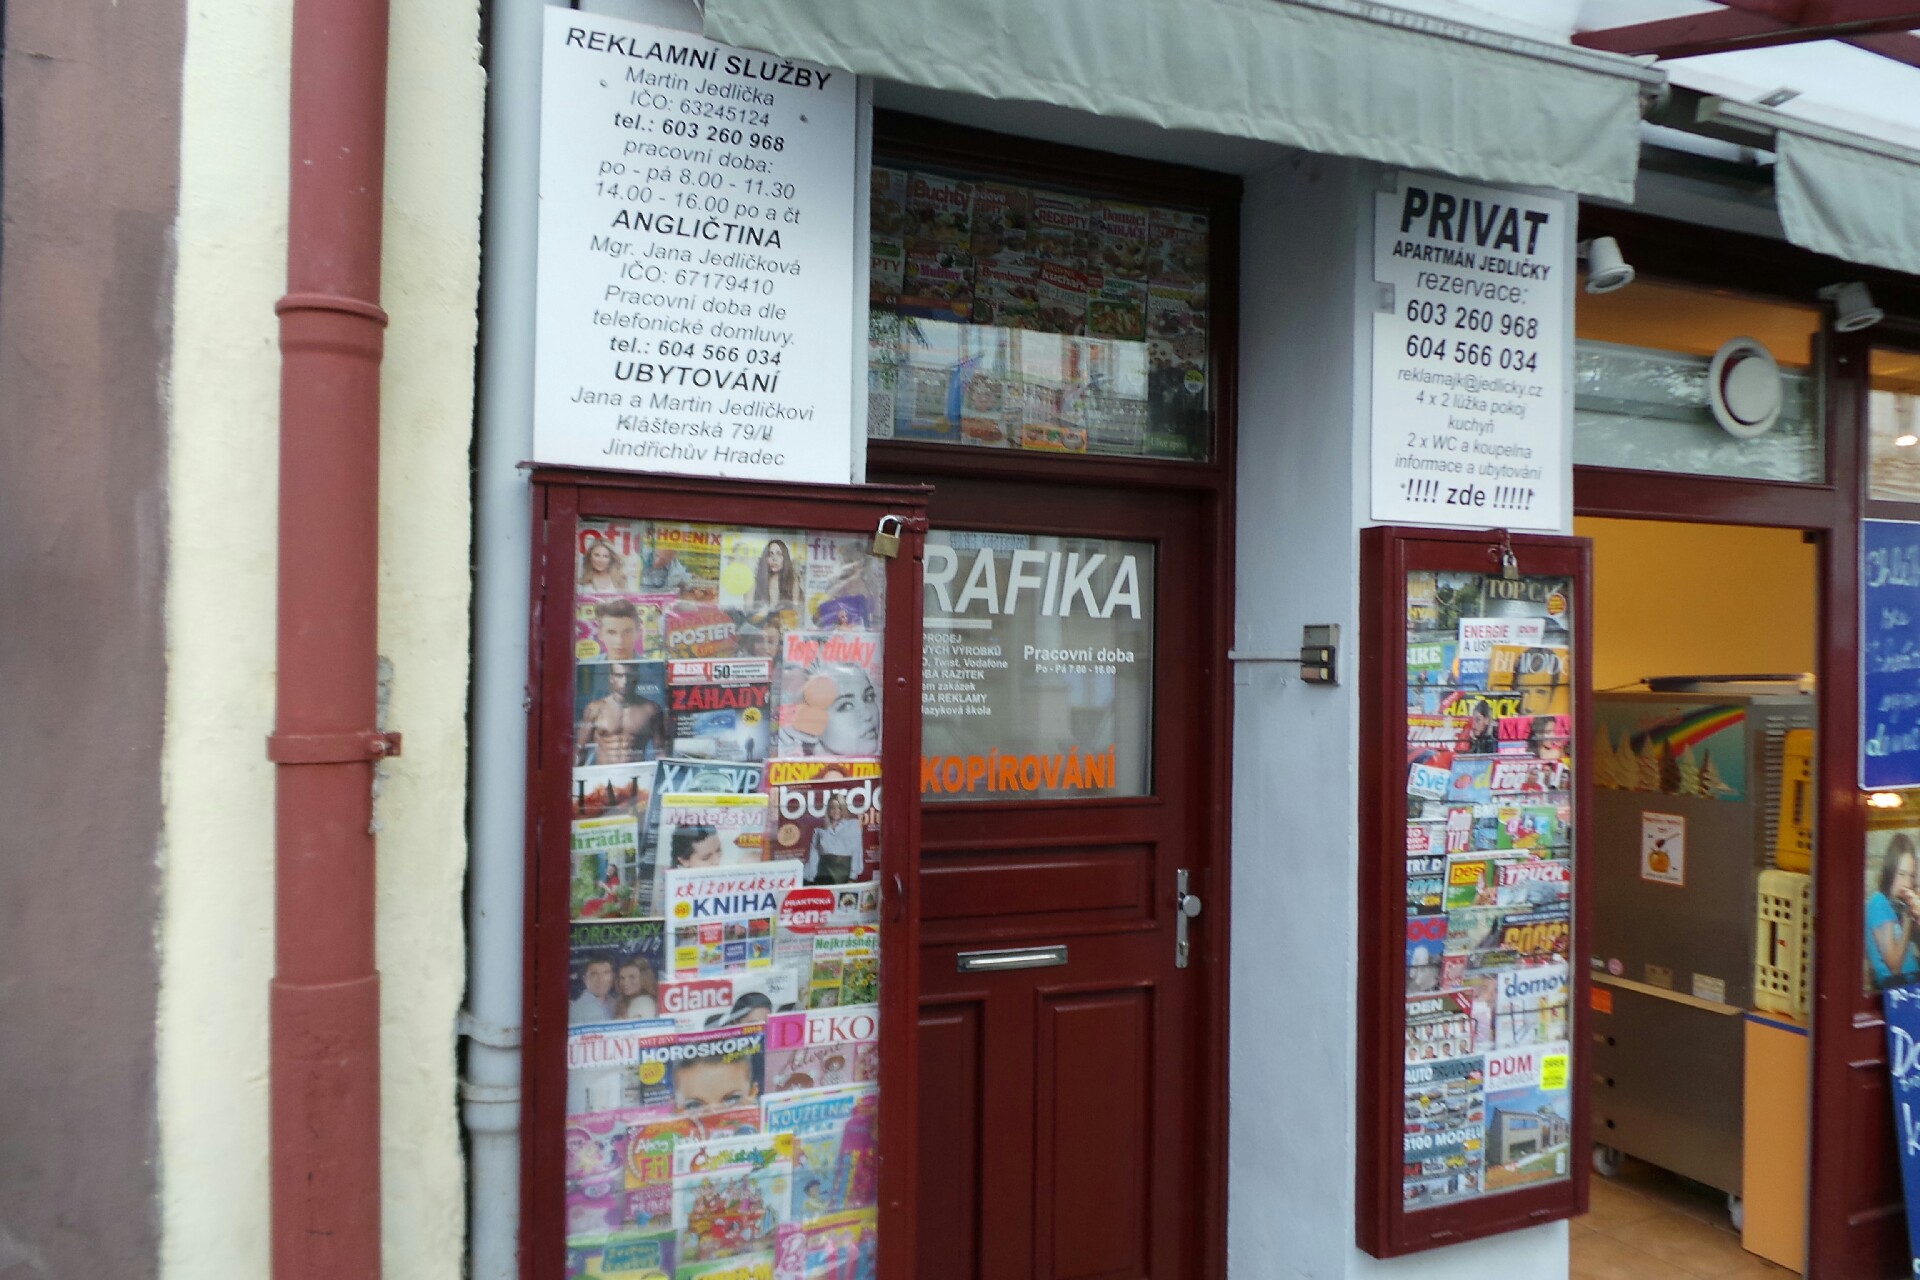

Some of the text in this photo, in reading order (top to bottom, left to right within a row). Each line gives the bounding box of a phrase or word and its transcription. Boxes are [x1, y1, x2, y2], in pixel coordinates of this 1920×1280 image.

[566, 27, 832, 91] REKLAMNÍ SLUŽBY
[625, 66, 775, 107] Martin Jedlička
[630, 89, 770, 127] IČO: 63245124
[614, 112, 785, 152] tel.: 603 260 968
[623, 138, 773, 174] pracovní doba:
[599, 159, 625, 179] po
[646, 163, 672, 184] pá
[679, 168, 723, 190] 8.00
[744, 179, 795, 201] 11.30
[595, 181, 652, 204] 14.00
[674, 191, 729, 215] 16.00
[734, 204, 759, 223] po
[765, 208, 777, 222] a
[783, 205, 801, 225] čt
[611, 208, 782, 250] ANGLIČTINA
[1400, 186, 1549, 255] PRIVAT
[589, 234, 802, 277] Mgr. Jana Jedličková
[1392, 240, 1551, 281] APARTMÁN JEDLIČKY
[620, 260, 774, 296] IČO: 67179410
[1417, 270, 1529, 305] rezervace:
[605, 284, 787, 321] Pracovní doba dle
[1407, 300, 1539, 339] 603 260 968
[593, 308, 795, 349] telefonické domluvy.
[610, 335, 782, 367] tel.: 604 566 034
[1406, 335, 1538, 373] 604 566 034
[614, 360, 781, 394] UBYTOVÁNÍ
[570, 386, 814, 422] Jana a Martin Jedličkovi
[1416, 390, 1425, 404] 4
[1441, 393, 1449, 408] 2
[1490, 401, 1527, 420] pokoj
[617, 413, 723, 439] Klášterská
[602, 438, 785, 467] Jindřichův Hradec
[1407, 432, 1416, 448] 2
[1433, 434, 1457, 452] WC
[1461, 441, 1469, 453] a
[1474, 440, 1532, 460] koupelna
[1395, 453, 1543, 481] informace a ubytování
[1446, 484, 1486, 507] zde
[669, 622, 737, 648] POSTER
[1464, 625, 1510, 639] ENERGIE
[963, 658, 1008, 669] Vodafone
[1023, 645, 1134, 662] Pracovní doba
[713, 665, 731, 680] 50
[672, 685, 769, 711] ZÁHADY
[938, 693, 988, 704] REKLAMY
[965, 705, 992, 716] škola
[921, 744, 1116, 793] KOPÍROVÁNÍ
[1416, 768, 1450, 791] Svě
[693, 892, 777, 918] KNIHA
[664, 985, 731, 1013] Glanc
[780, 1014, 876, 1048] DEKO
[641, 1036, 762, 1064] HOROSKOPY
